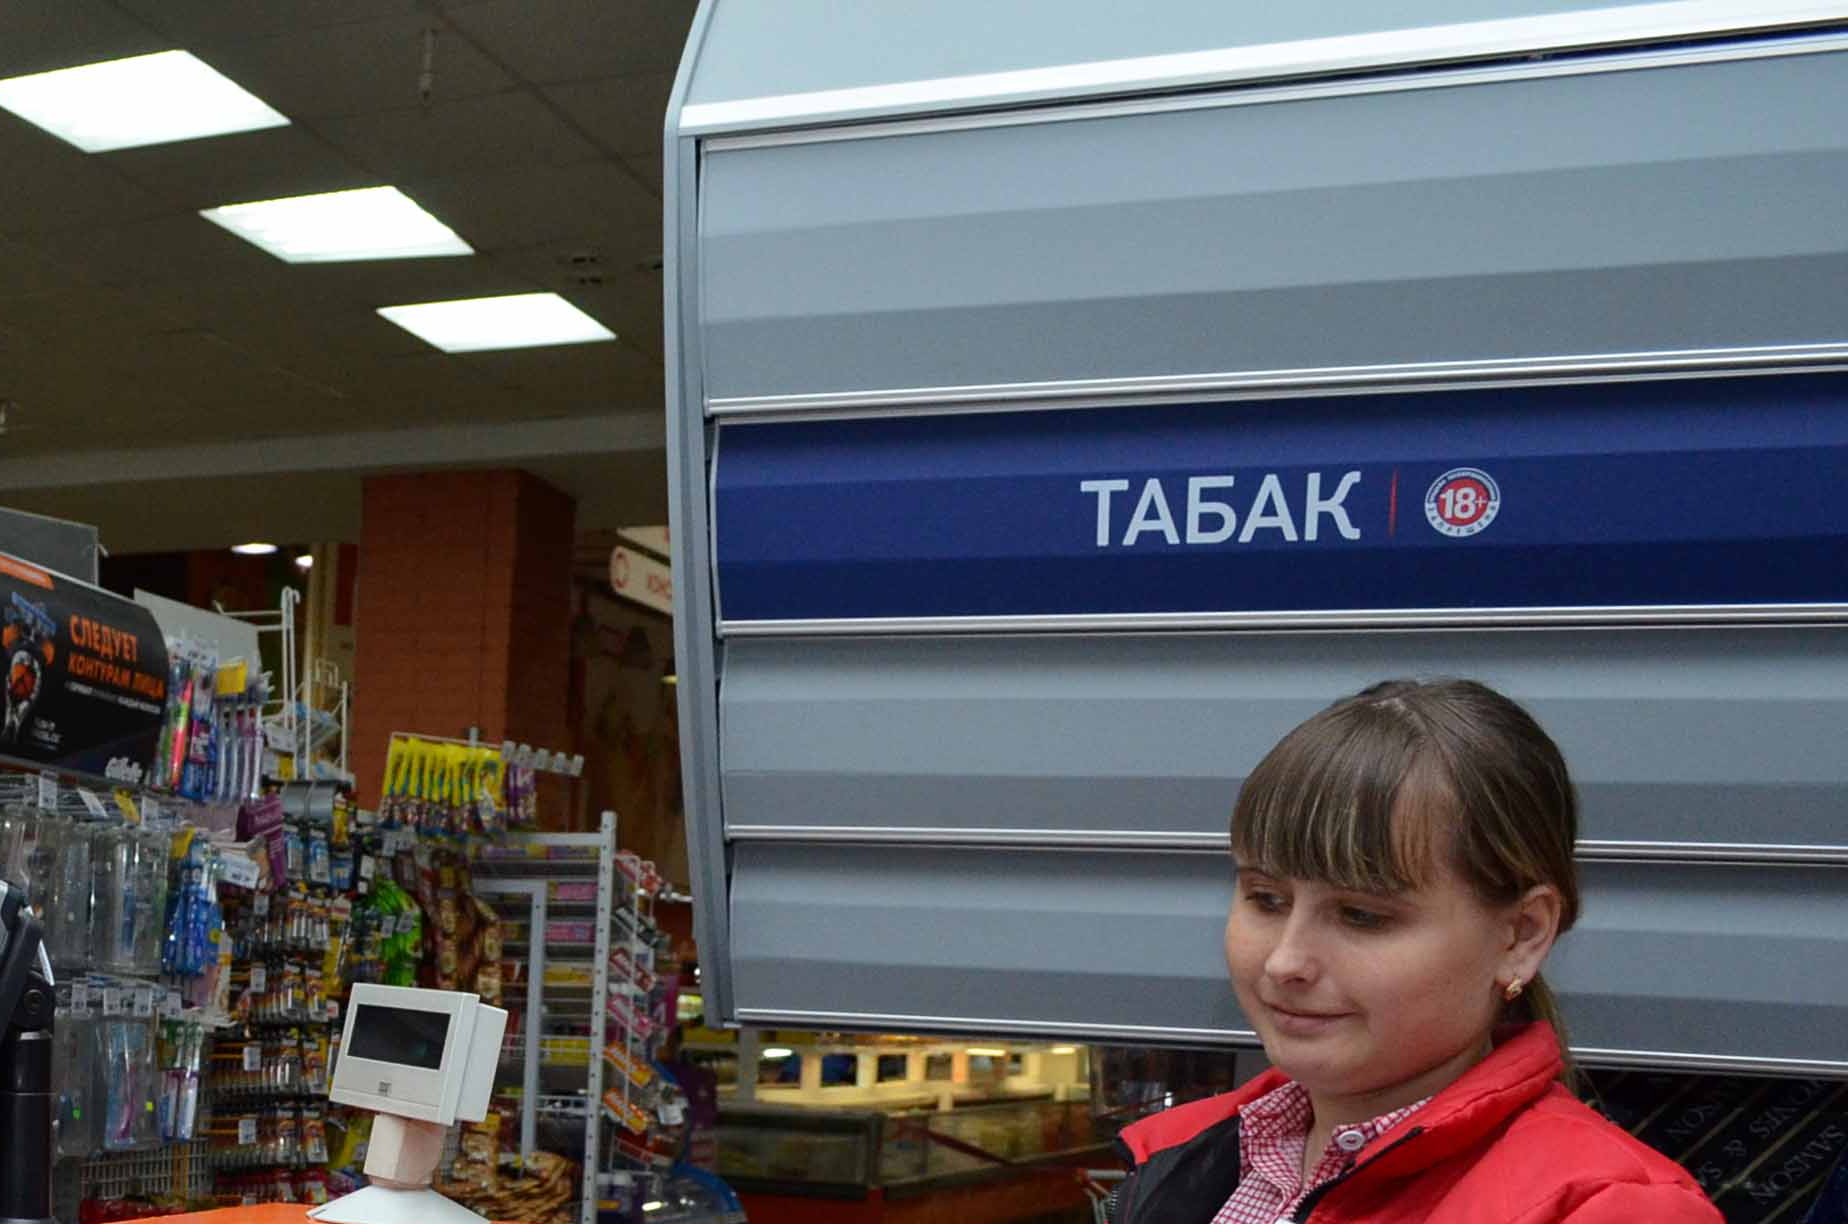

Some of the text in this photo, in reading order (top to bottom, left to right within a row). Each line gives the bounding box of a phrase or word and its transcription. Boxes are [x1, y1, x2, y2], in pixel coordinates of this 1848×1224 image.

[1080, 471, 1361, 547] ТАБАК
[1439, 487, 1488, 519] 18+
[69, 613, 137, 662] СЛЕДУЕТ
